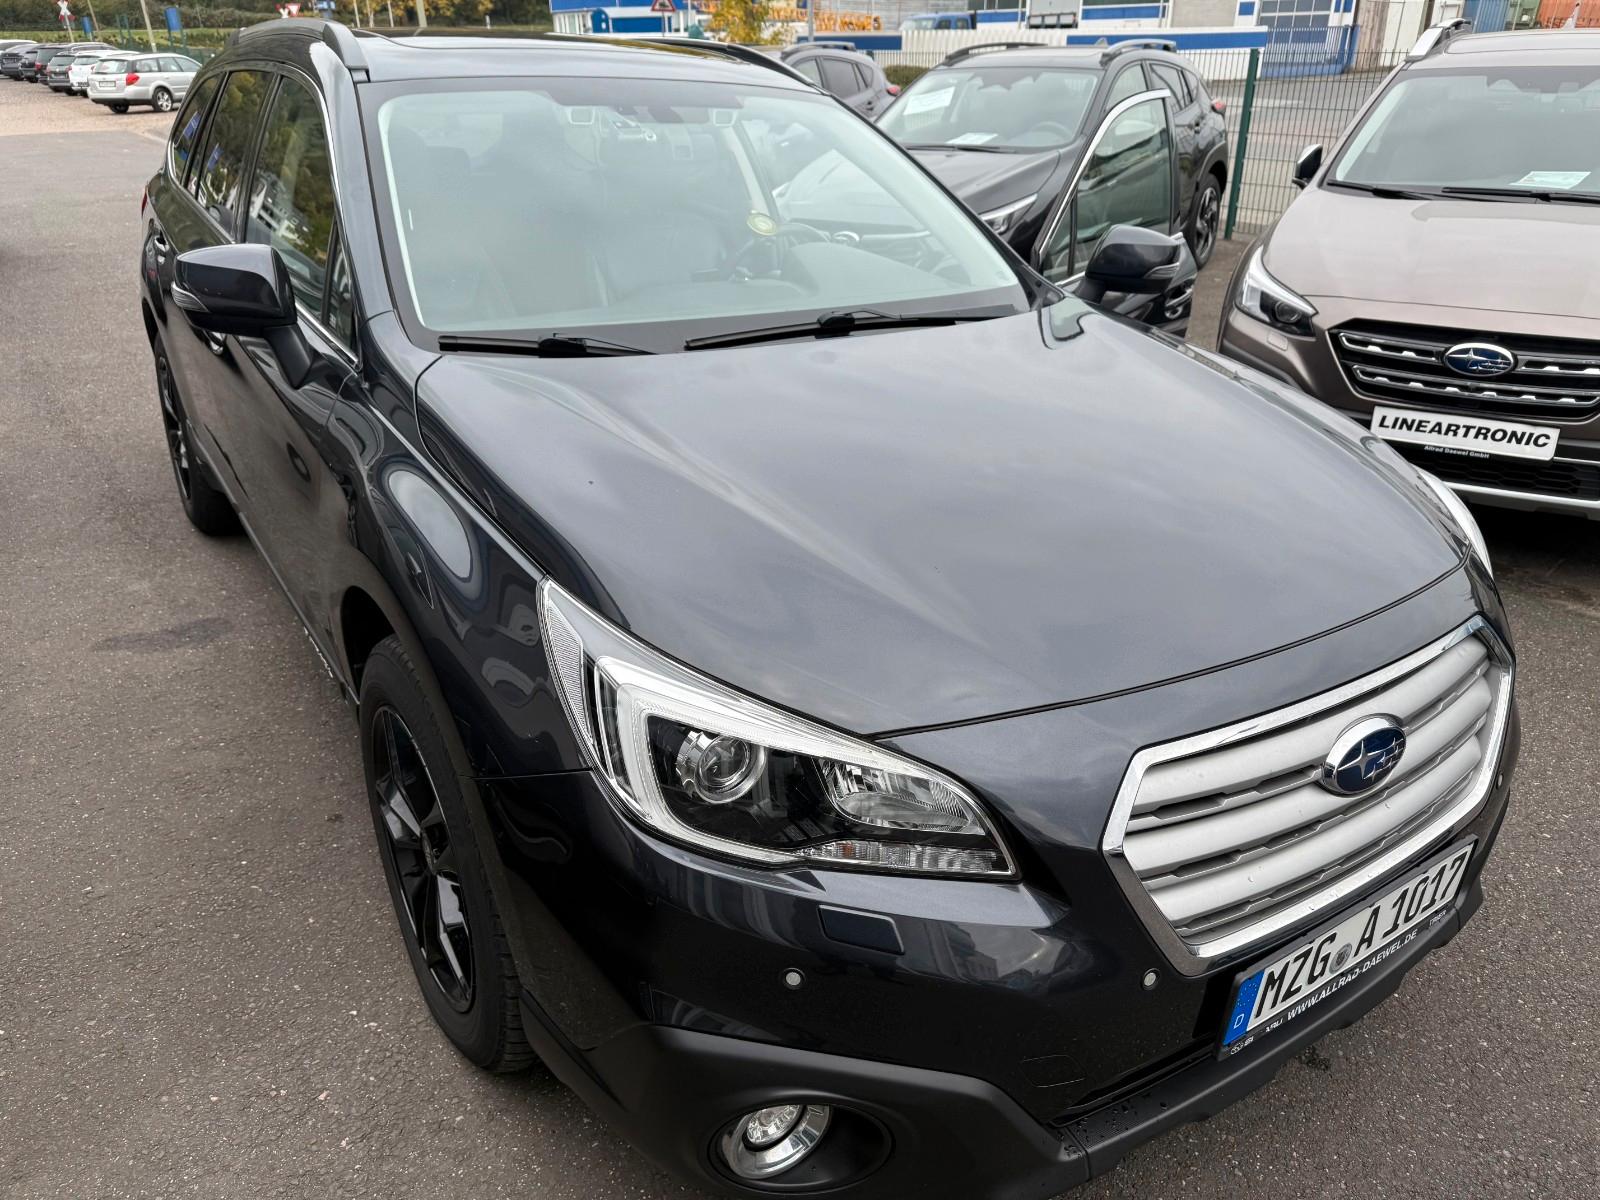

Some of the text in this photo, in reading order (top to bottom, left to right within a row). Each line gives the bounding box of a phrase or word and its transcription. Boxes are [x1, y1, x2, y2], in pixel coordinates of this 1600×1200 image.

[1378, 414, 1551, 448] LINEARTRONIC
[1255, 851, 1468, 1018] MZG A 1017
[1287, 929, 1418, 1020] WWW.ALLRAD-DAEWEL.DE
[1233, 1013, 1244, 1028] D
